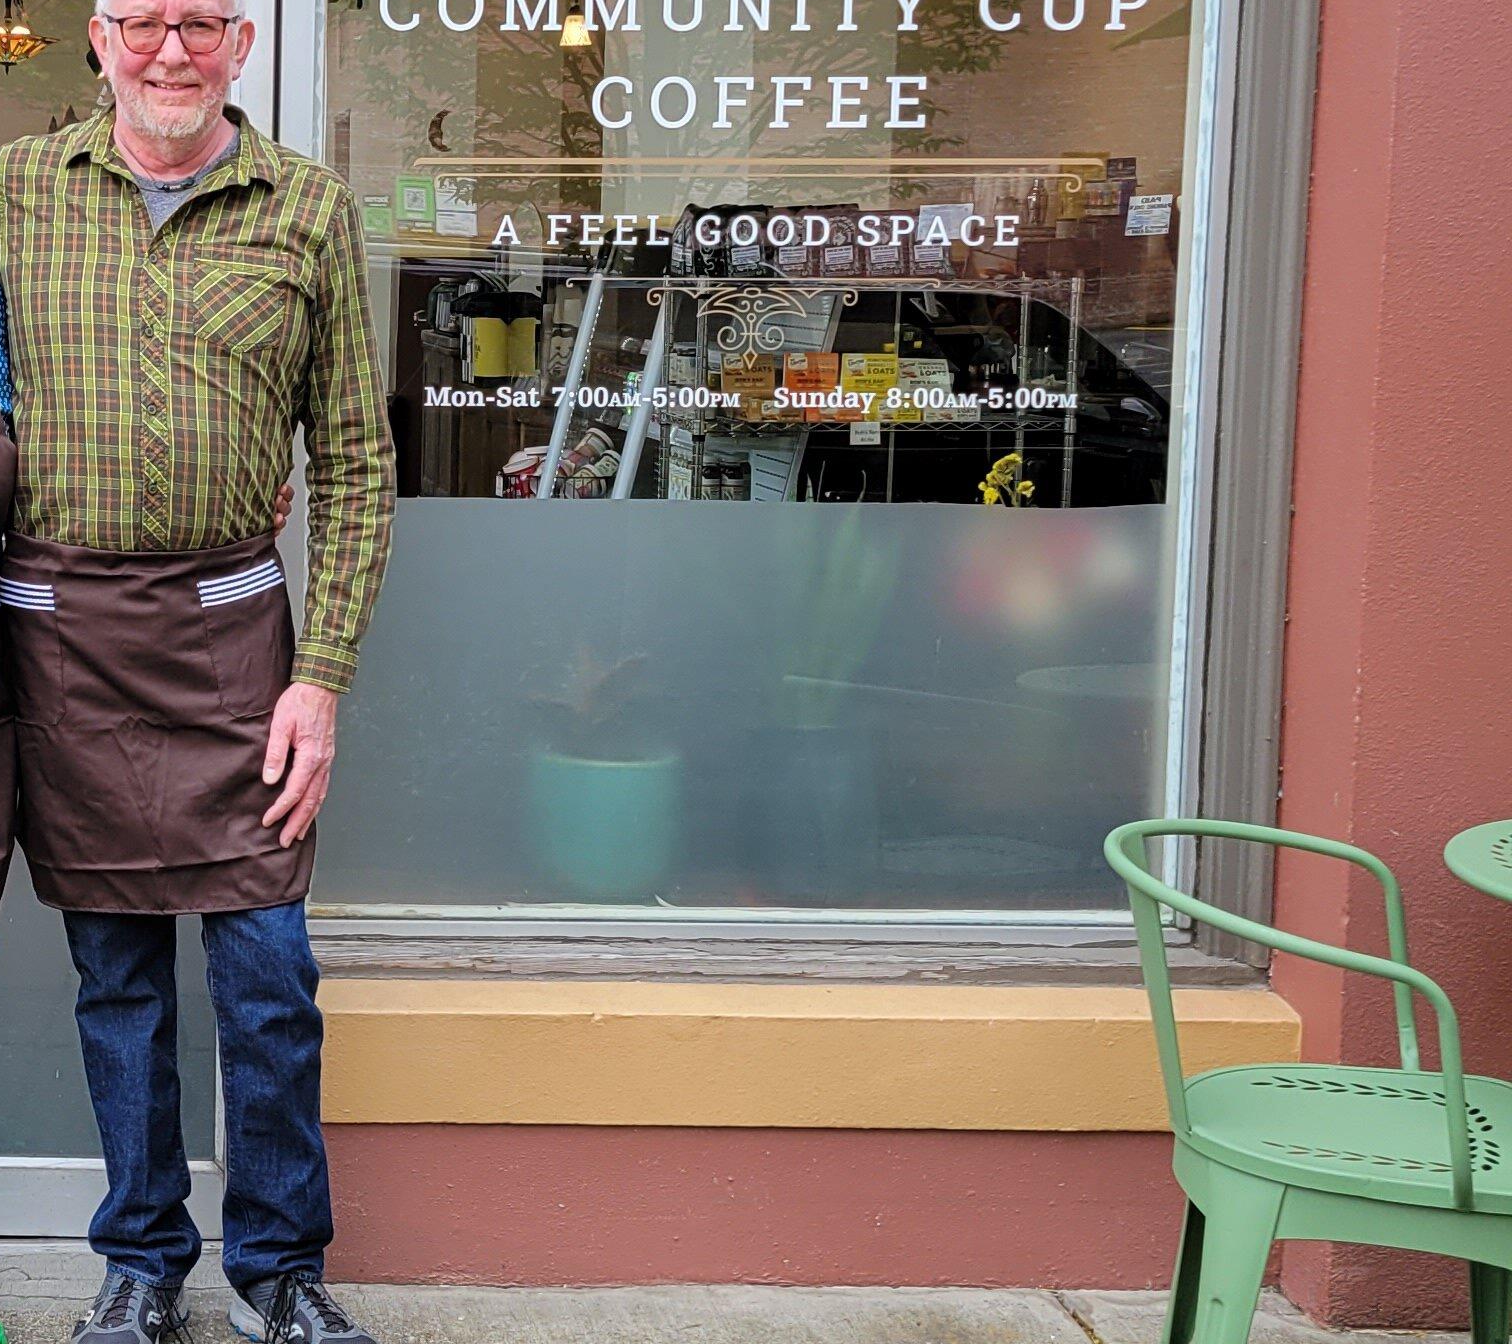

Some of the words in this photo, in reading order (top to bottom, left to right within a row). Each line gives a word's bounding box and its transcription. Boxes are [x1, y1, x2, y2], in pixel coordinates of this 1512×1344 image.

[590, 75, 928, 130] COFFEE
[491, 214, 522, 247] A
[546, 213, 671, 248] FEEL
[694, 213, 831, 248] GOOD
[856, 214, 1022, 248] SPACE
[423, 386, 541, 409] Mon-Sat
[551, 387, 742, 409] 7:00AM-5:00PM
[773, 385, 877, 414] Sunday
[886, 387, 1079, 410] 8:00AM-5:00PM
